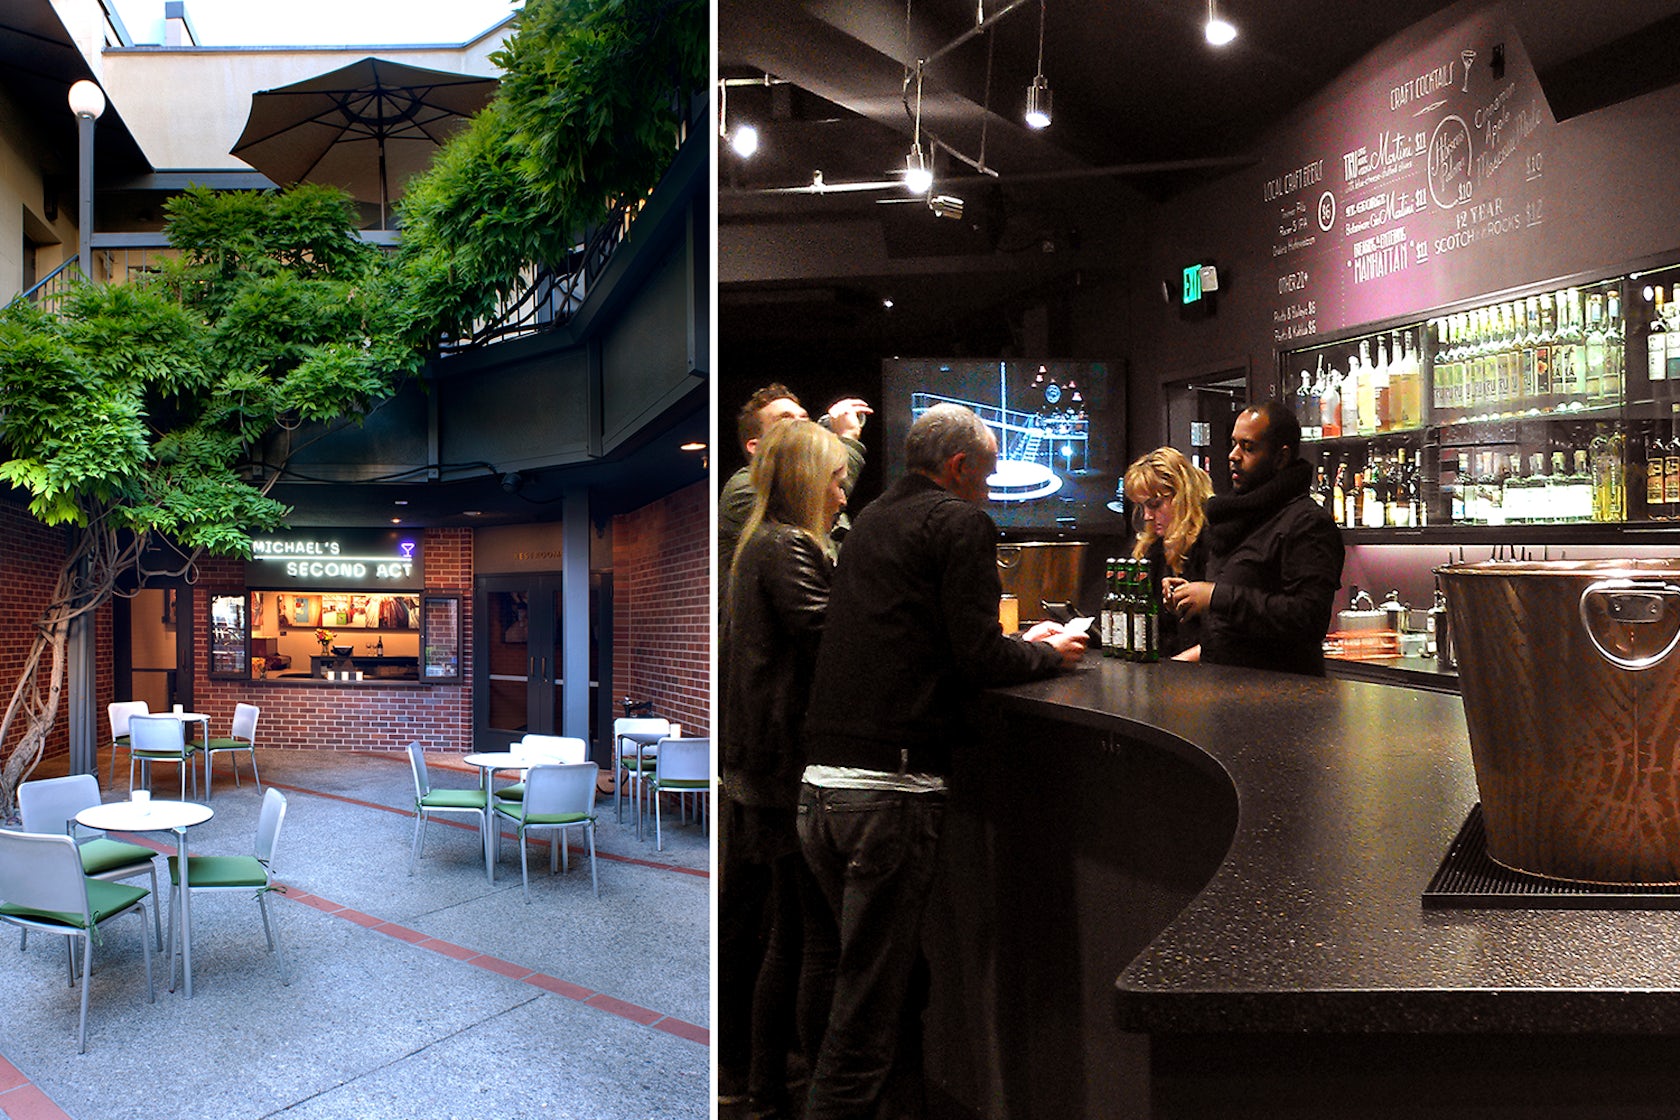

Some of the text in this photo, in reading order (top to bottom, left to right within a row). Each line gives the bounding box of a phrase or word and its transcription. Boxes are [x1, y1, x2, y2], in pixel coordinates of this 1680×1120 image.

[1390, 61, 1454, 111] CRAFT COCKTAILS
[1485, 105, 1510, 149] Apple
[1370, 131, 1412, 170] Martini
[1263, 178, 1283, 202] LOCAL
[1284, 168, 1303, 194] CRAFT
[1458, 181, 1472, 204] $10
[1379, 190, 1415, 225] Martini
[1456, 210, 1468, 230] 12
[1470, 198, 1503, 224] YEAR
[1434, 228, 1475, 254] SCOTCH
[1487, 214, 1521, 236] ROCKS
[1354, 242, 1408, 284] MANHATTAN
[253, 540, 341, 556] MICHAEL'S
[286, 560, 413, 578] SECOND ACT
